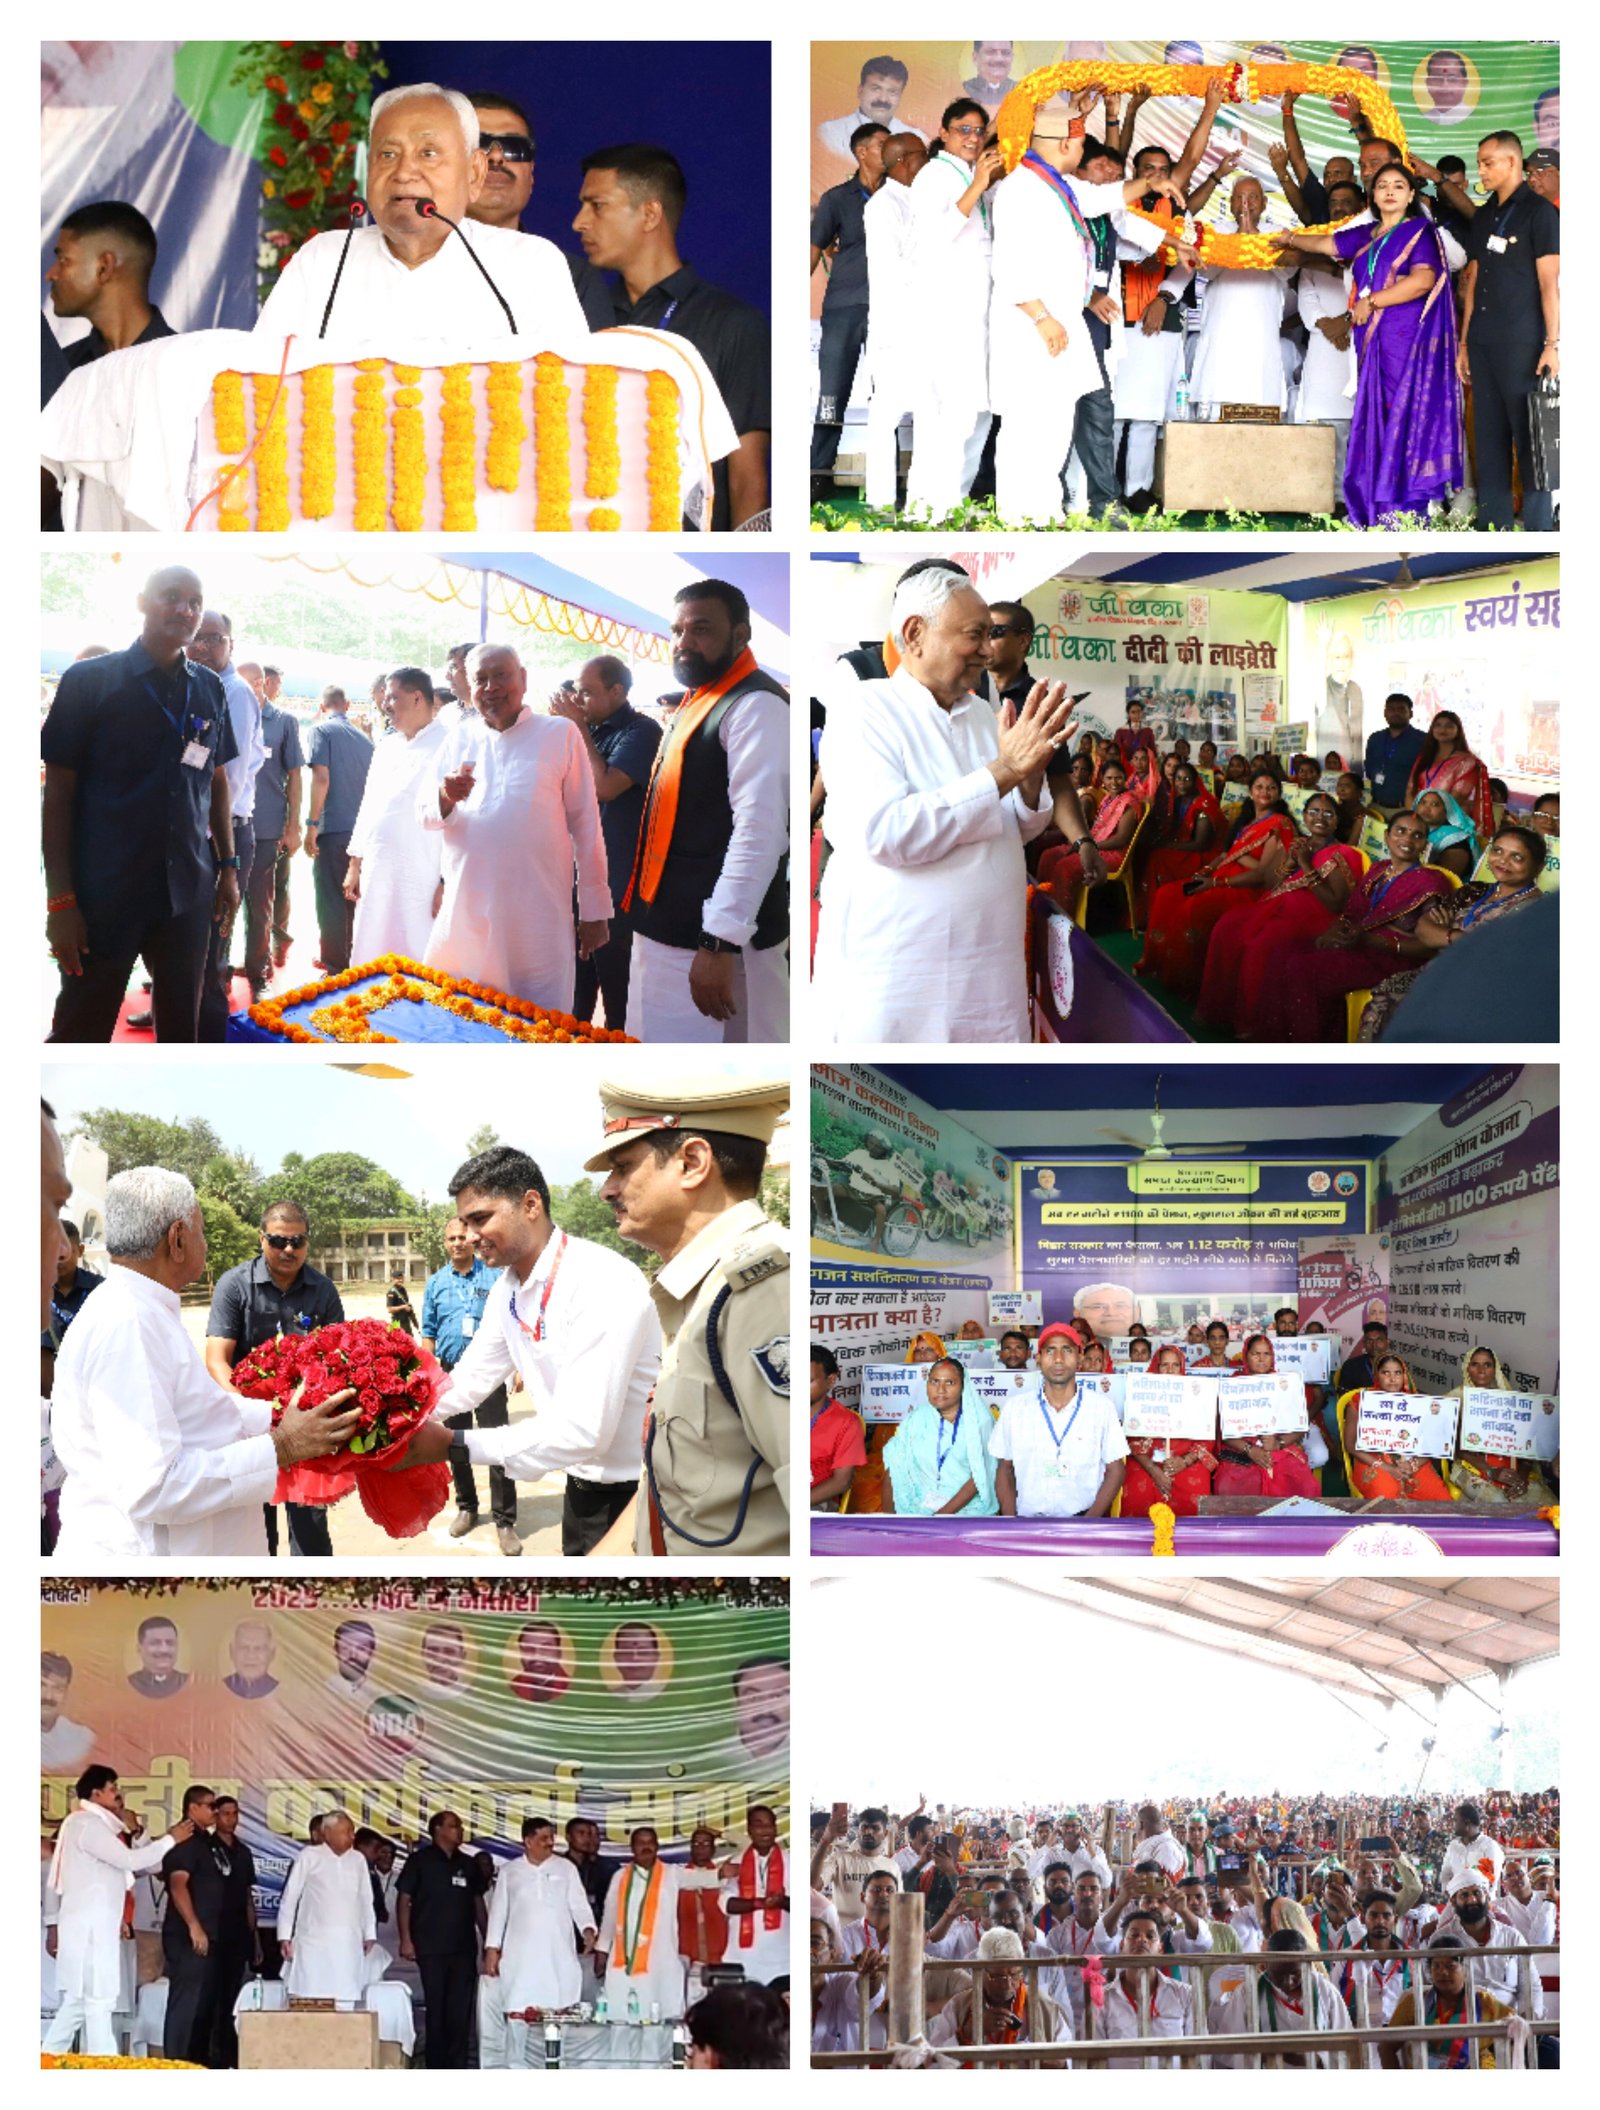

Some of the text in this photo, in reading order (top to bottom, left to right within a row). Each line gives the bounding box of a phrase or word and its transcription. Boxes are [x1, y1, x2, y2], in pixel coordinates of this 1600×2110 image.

[1085, 591, 1184, 618] जीविका
[1464, 580, 1520, 632] स्वयं
[1123, 635, 1168, 664] दीदी
[1175, 636, 1203, 665] की
[1208, 639, 1278, 671] लाइब्रेरी
[1480, 1110, 1522, 1147] योजना
[1450, 1184, 1489, 1215] 1100
[1467, 1251, 1502, 1271] वितरण
[1503, 1246, 1521, 1267] की
[884, 1309, 917, 1326] क्या
[921, 1303, 942, 1325] है?
[1486, 1304, 1527, 1326] वितरण
[1515, 1370, 1540, 1393] कुल
[1518, 1398, 1533, 1411] का
[369, 1712, 418, 1737] NDA
